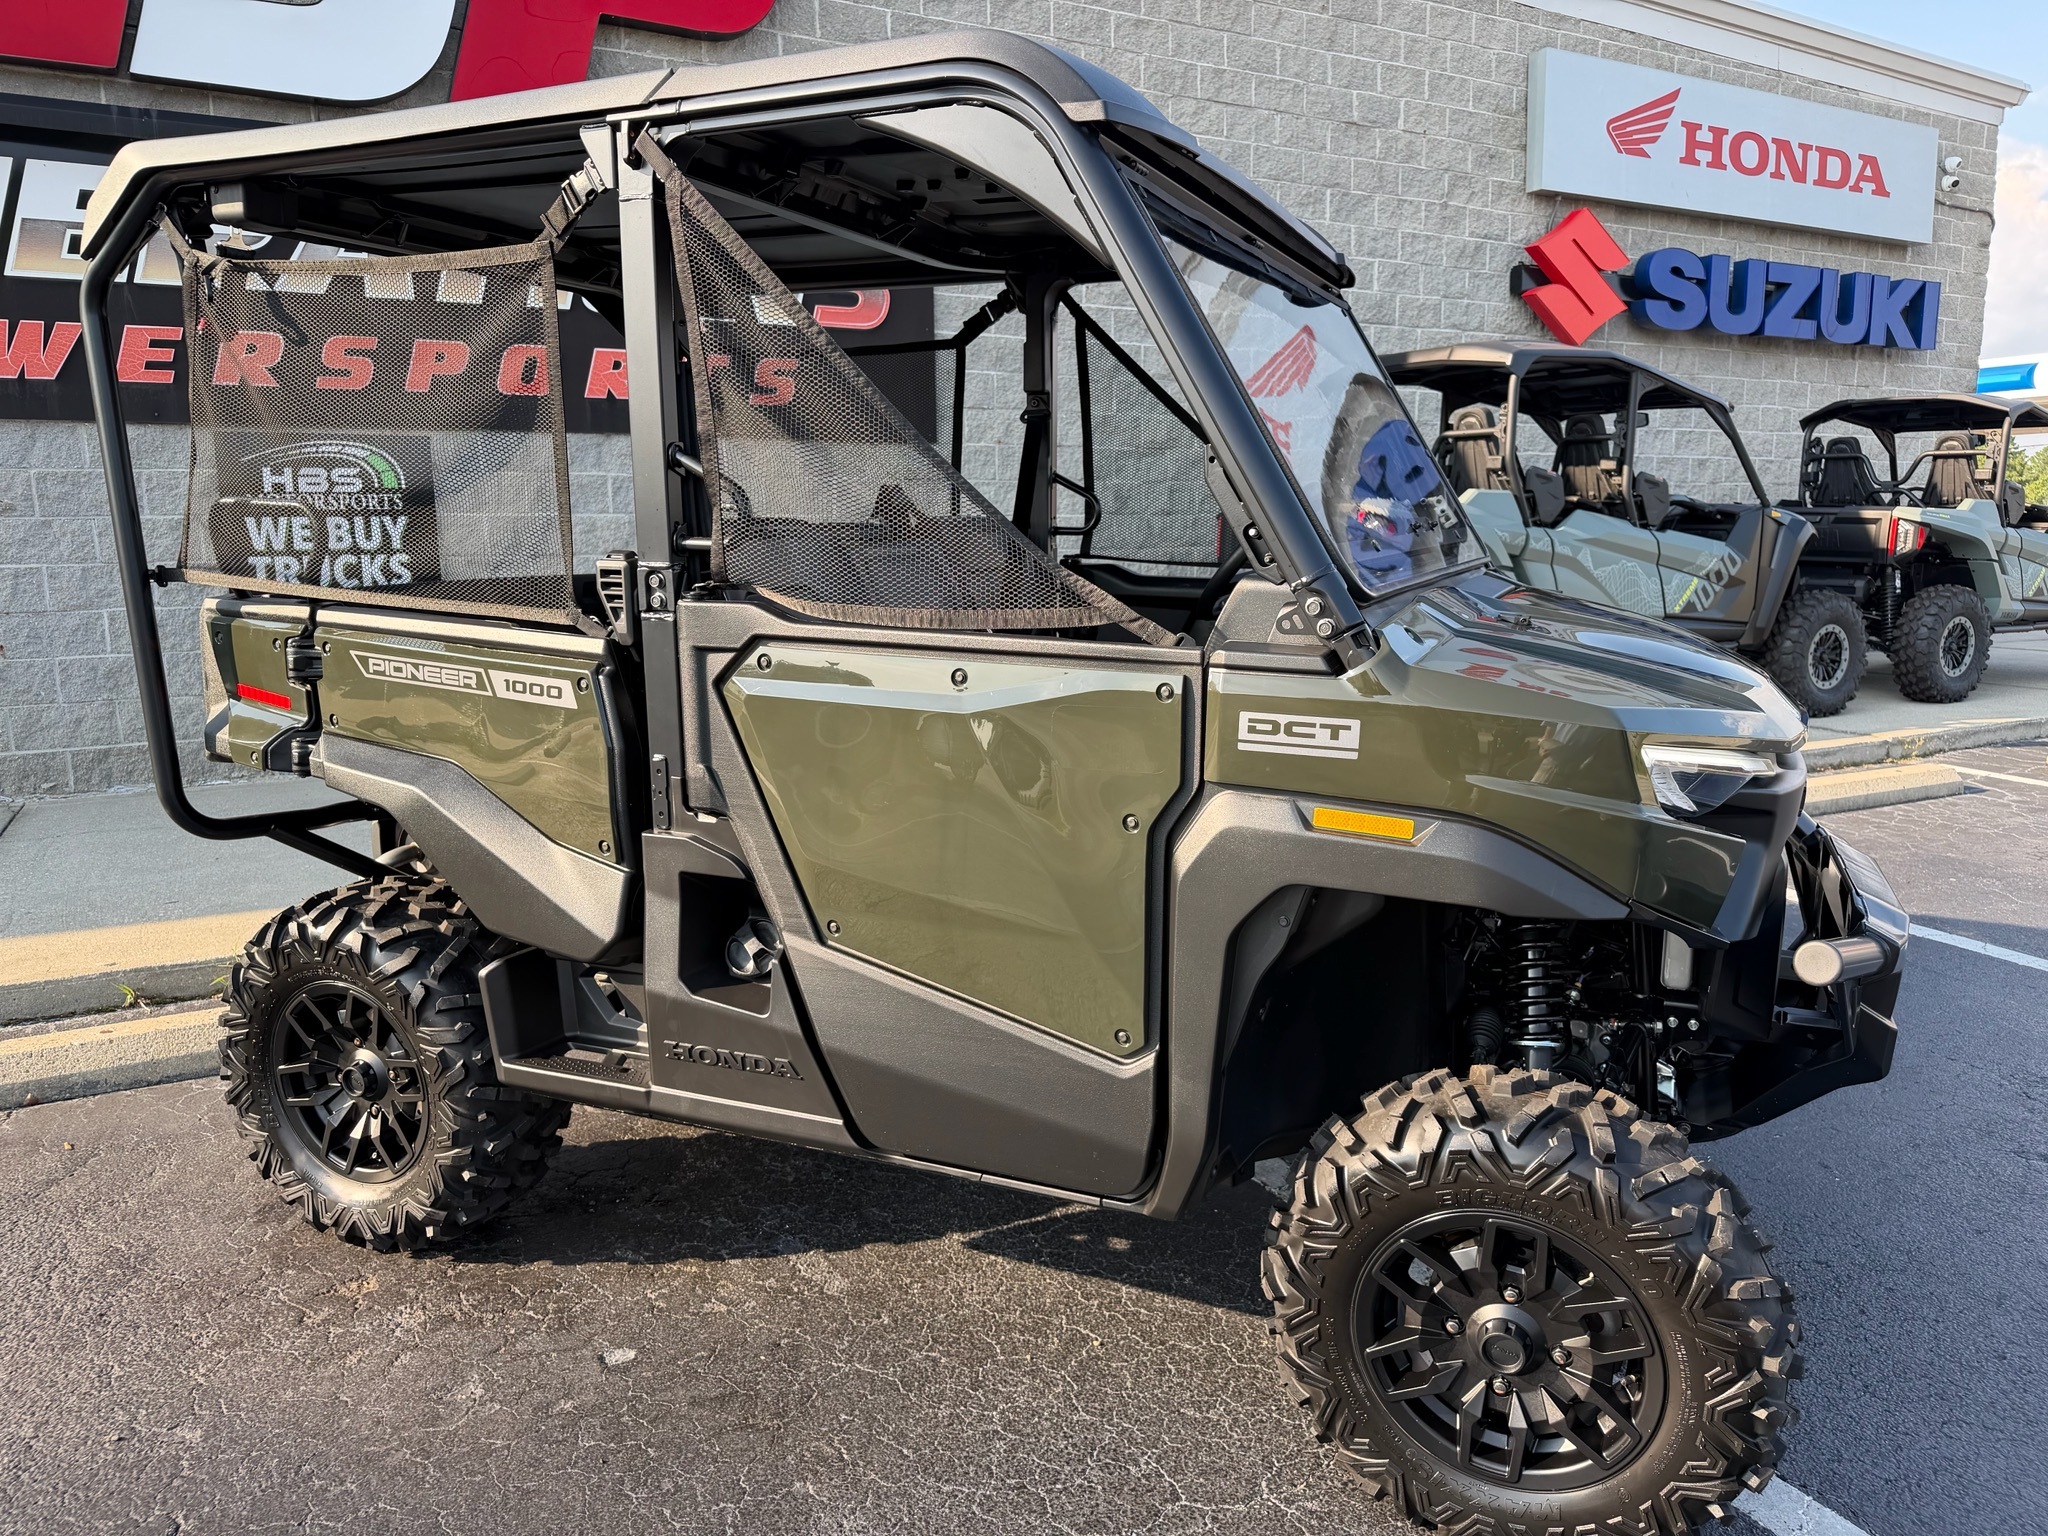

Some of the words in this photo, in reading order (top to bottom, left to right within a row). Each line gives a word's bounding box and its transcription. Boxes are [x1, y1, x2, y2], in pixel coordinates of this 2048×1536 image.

[1679, 120, 1890, 198] HONDA
[1635, 247, 1940, 350] SUZUKI
[245, 516, 314, 551] WE
[326, 516, 408, 551] BUY
[1690, 547, 1742, 612] 1000
[368, 657, 477, 689] PIONEER
[503, 678, 563, 700] 1000
[1247, 717, 1351, 741] DCT
[664, 1040, 804, 1080] HONDA
[1435, 1188, 1609, 1244] BIGHORN
